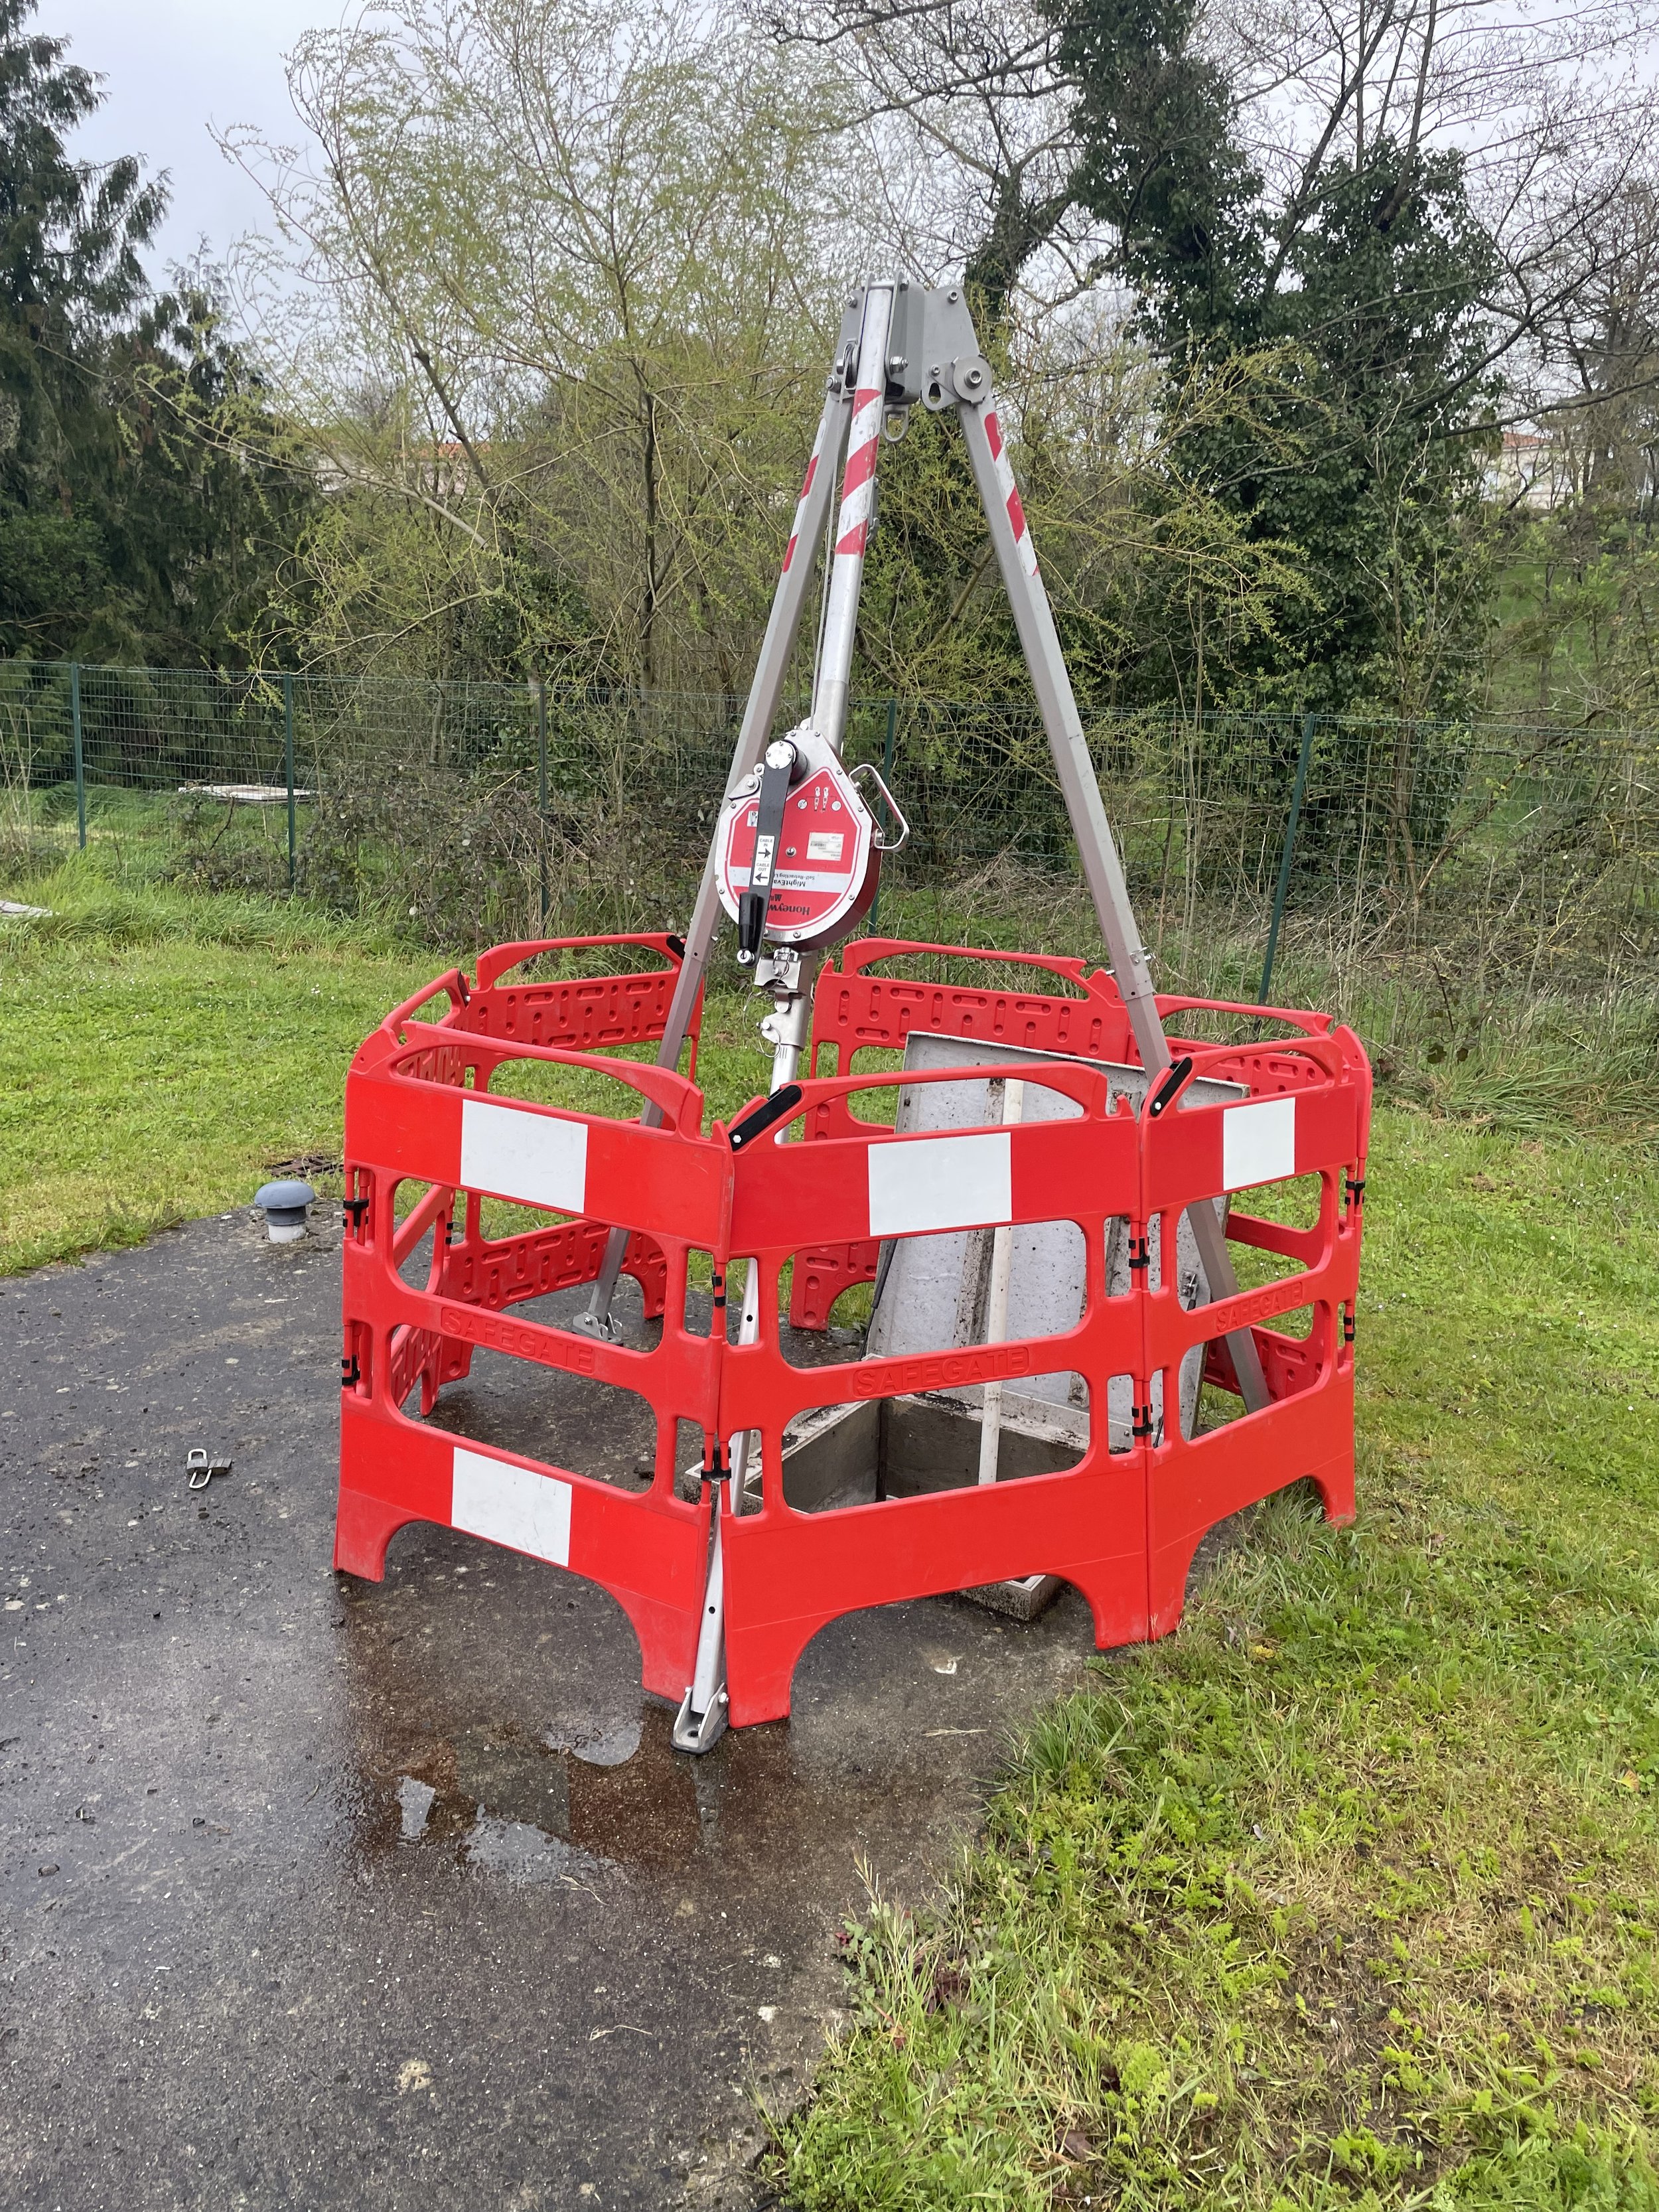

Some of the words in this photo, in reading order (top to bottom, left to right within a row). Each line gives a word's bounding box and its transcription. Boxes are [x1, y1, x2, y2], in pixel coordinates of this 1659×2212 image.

[770, 903, 810, 915] Honeyw
[1216, 1288, 1301, 1332] SAFEGATE
[445, 1310, 594, 1372] SAFEGATE
[855, 1347, 1026, 1396] SAFEGATE
